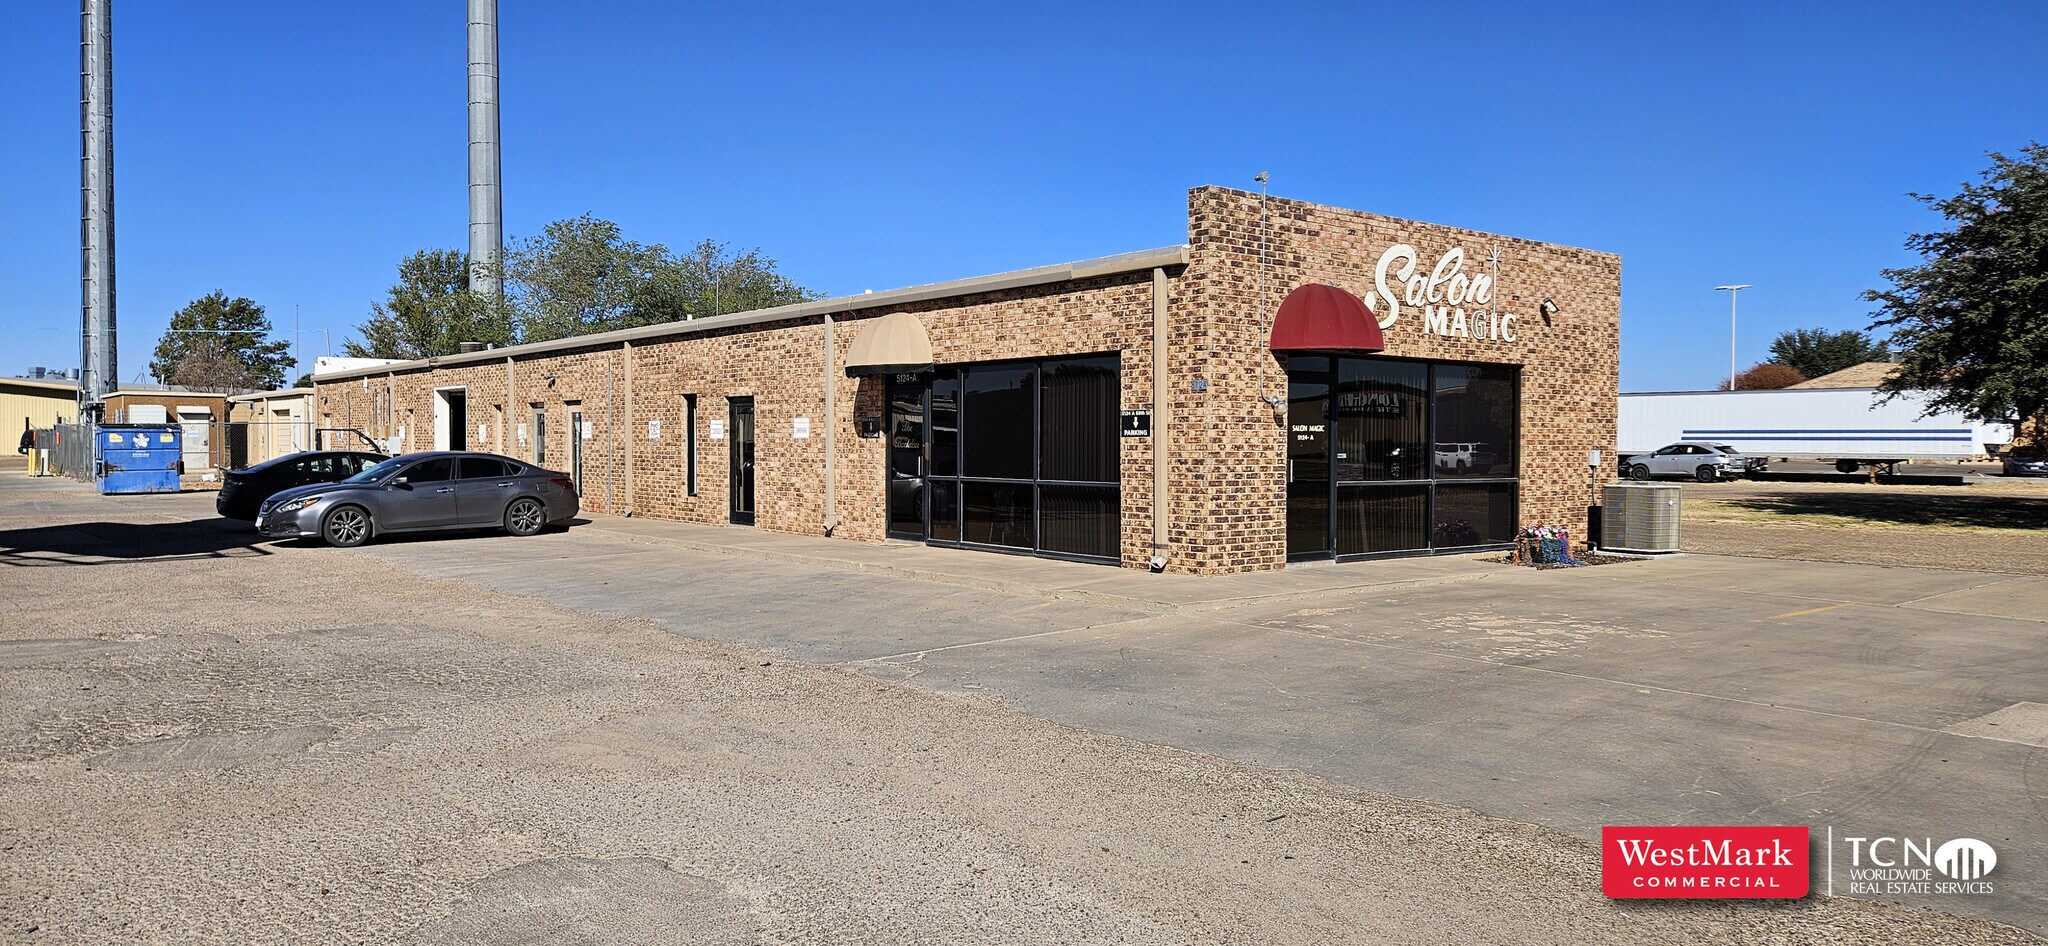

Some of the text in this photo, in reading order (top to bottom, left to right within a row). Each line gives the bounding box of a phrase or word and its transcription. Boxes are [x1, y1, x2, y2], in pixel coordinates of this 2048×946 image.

[1365, 244, 1492, 329] Salon
[1424, 305, 1516, 342] MAGIC
[896, 373, 917, 383] 5124-A
[901, 421, 913, 432] The
[1292, 424, 1326, 432] SALON MAGIC
